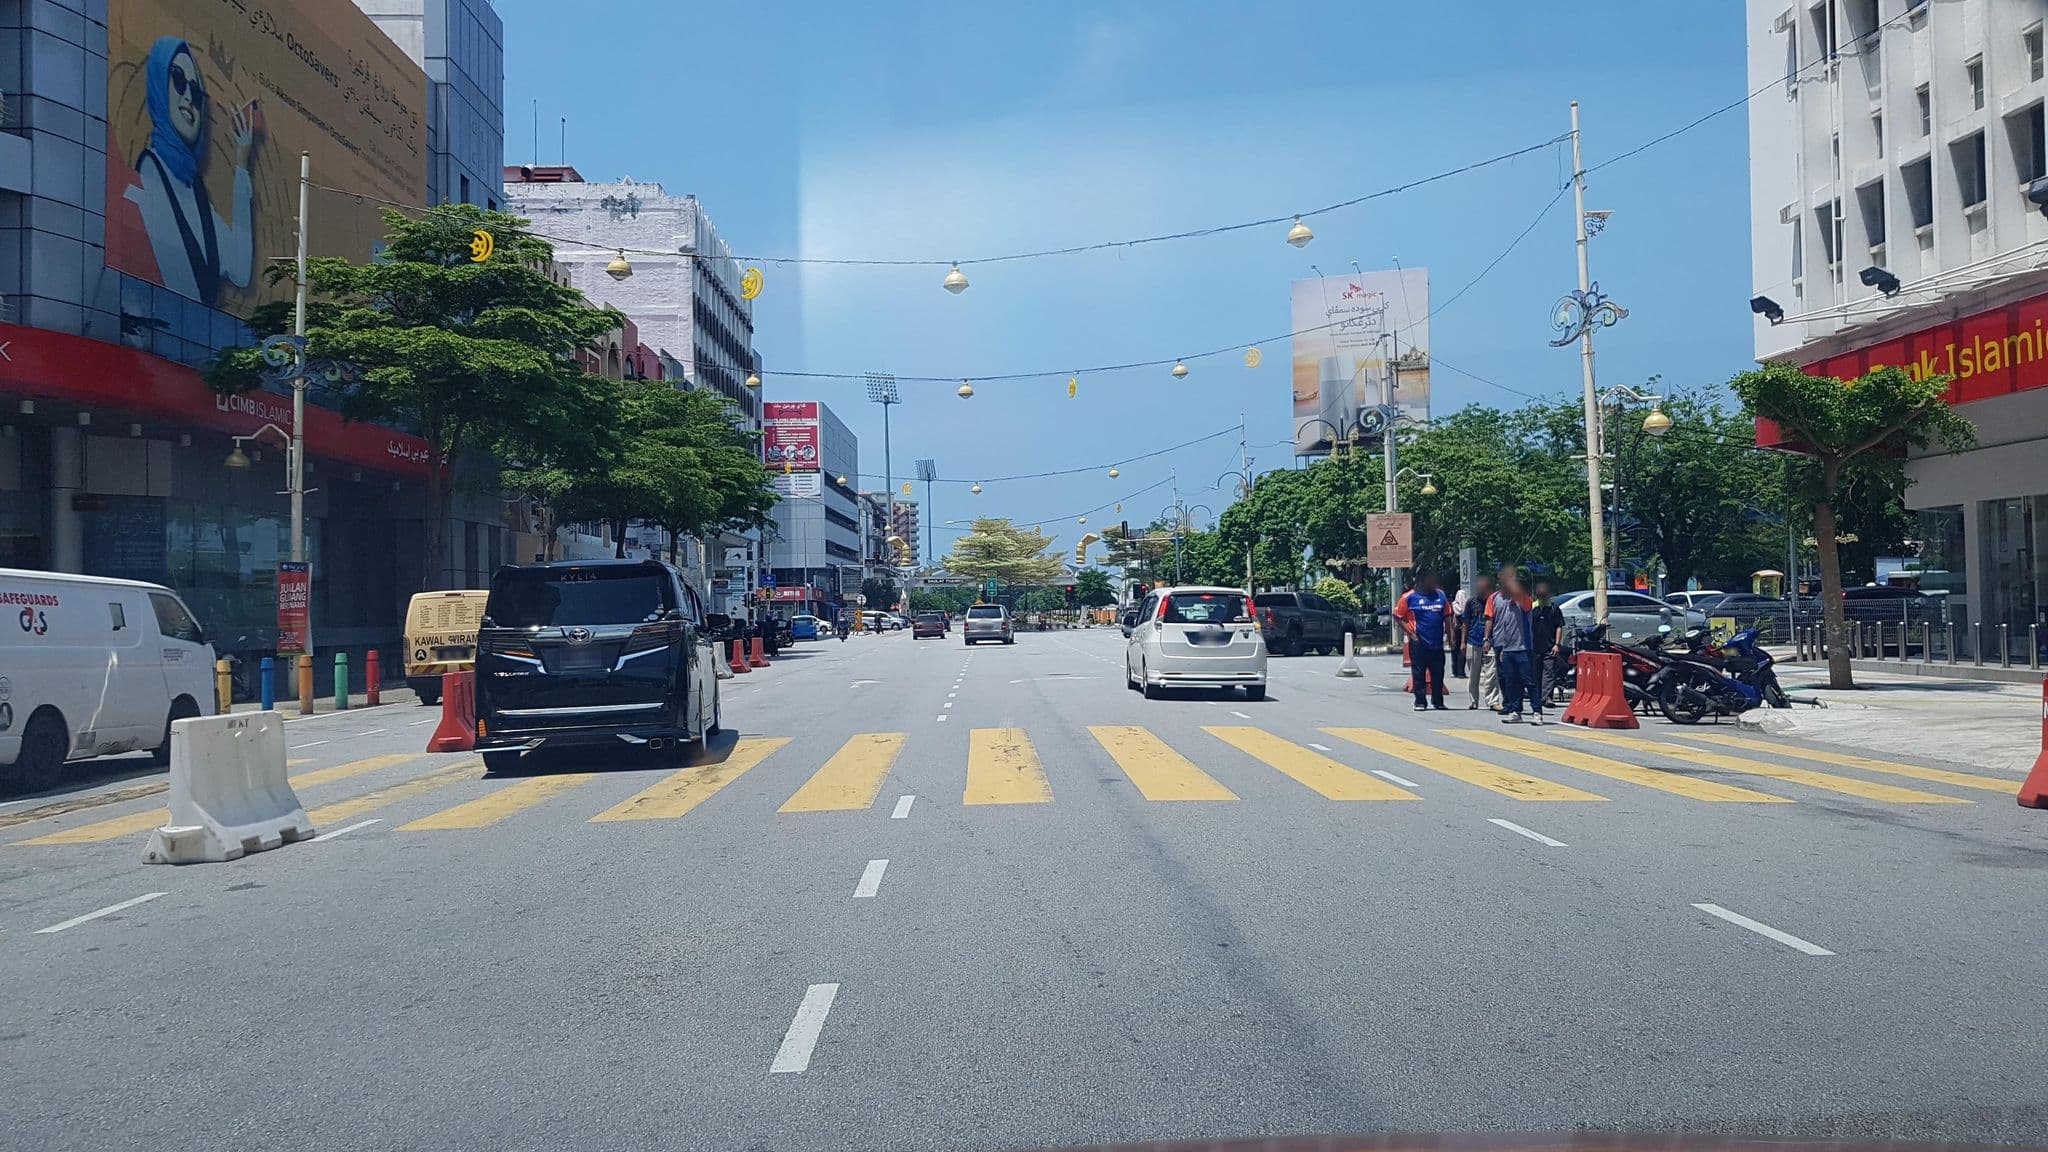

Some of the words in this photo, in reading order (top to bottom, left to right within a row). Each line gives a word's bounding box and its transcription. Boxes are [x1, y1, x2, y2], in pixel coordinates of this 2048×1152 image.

[286, 33, 340, 88] OctoSavers
[1945, 318, 2048, 381] Islami
[414, 635, 445, 646] KAWAL
